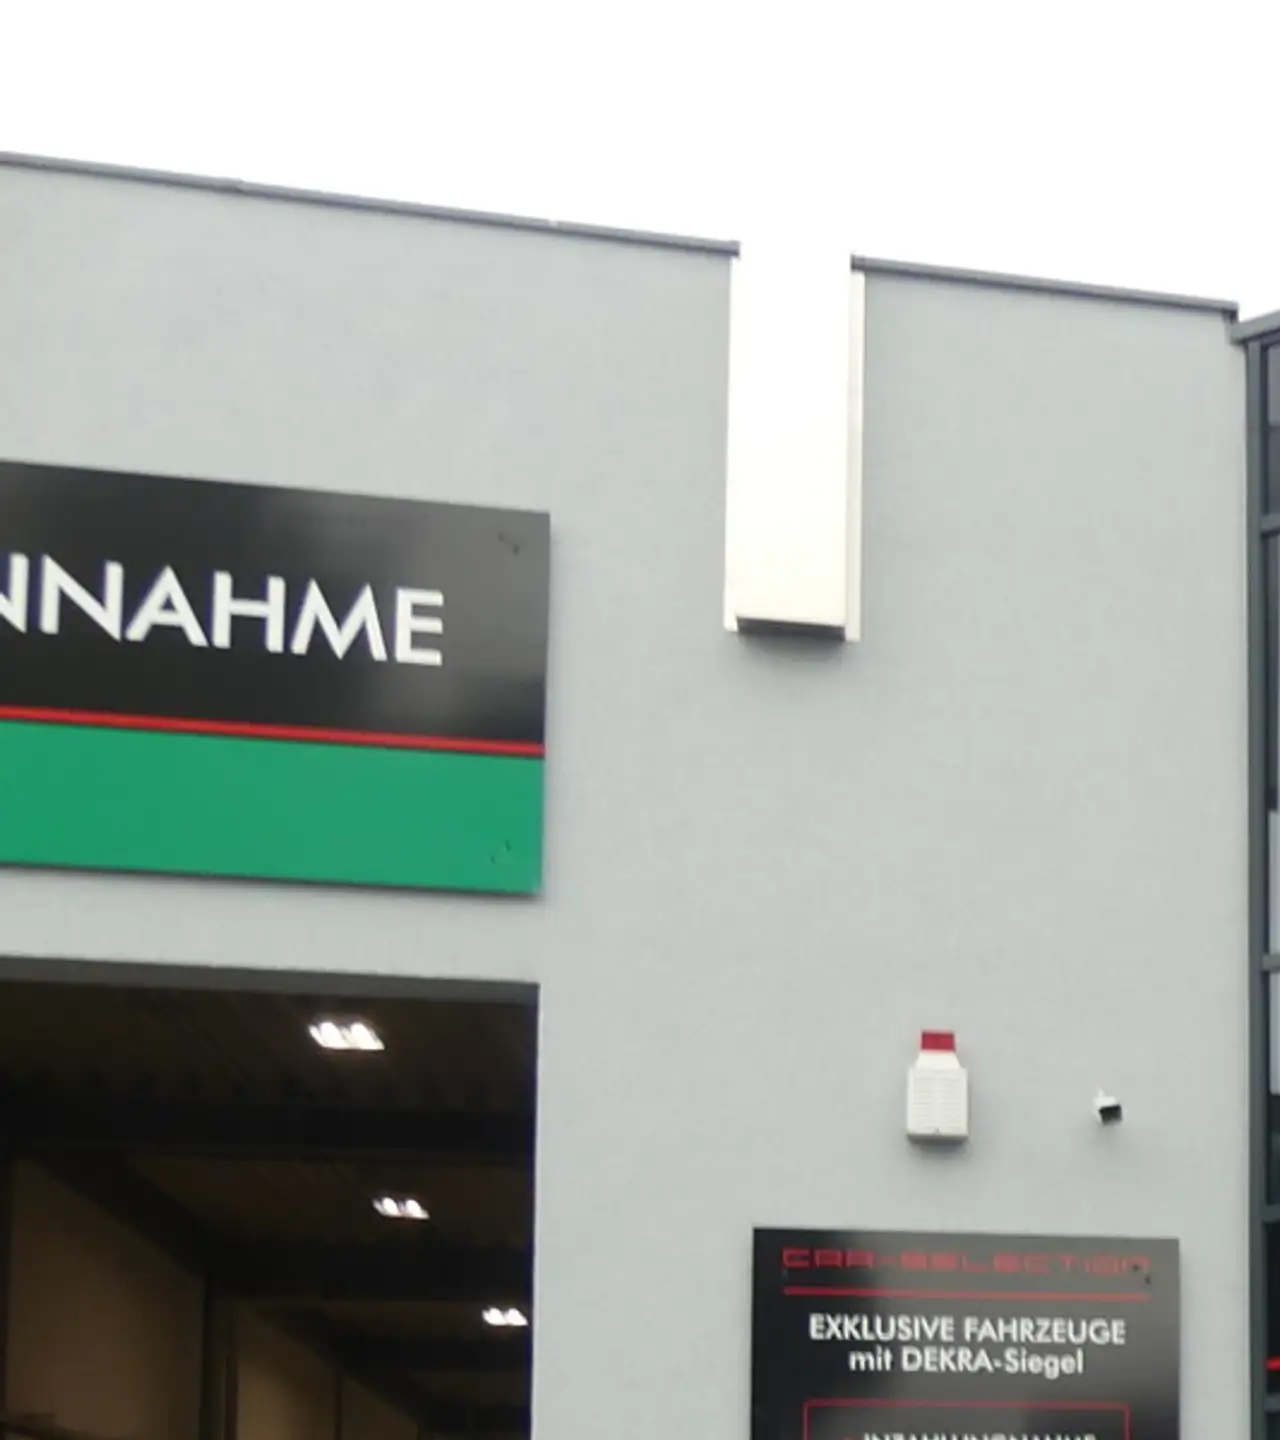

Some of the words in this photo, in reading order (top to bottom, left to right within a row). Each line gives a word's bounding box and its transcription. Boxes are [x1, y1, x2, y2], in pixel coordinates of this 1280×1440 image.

[809, 1313, 954, 1342] EXKLUSIVE
[964, 1318, 1126, 1345] FAHRZEUGE
[849, 1347, 893, 1372] mit
[902, 1348, 1084, 1379] DEKRA-Siegel
